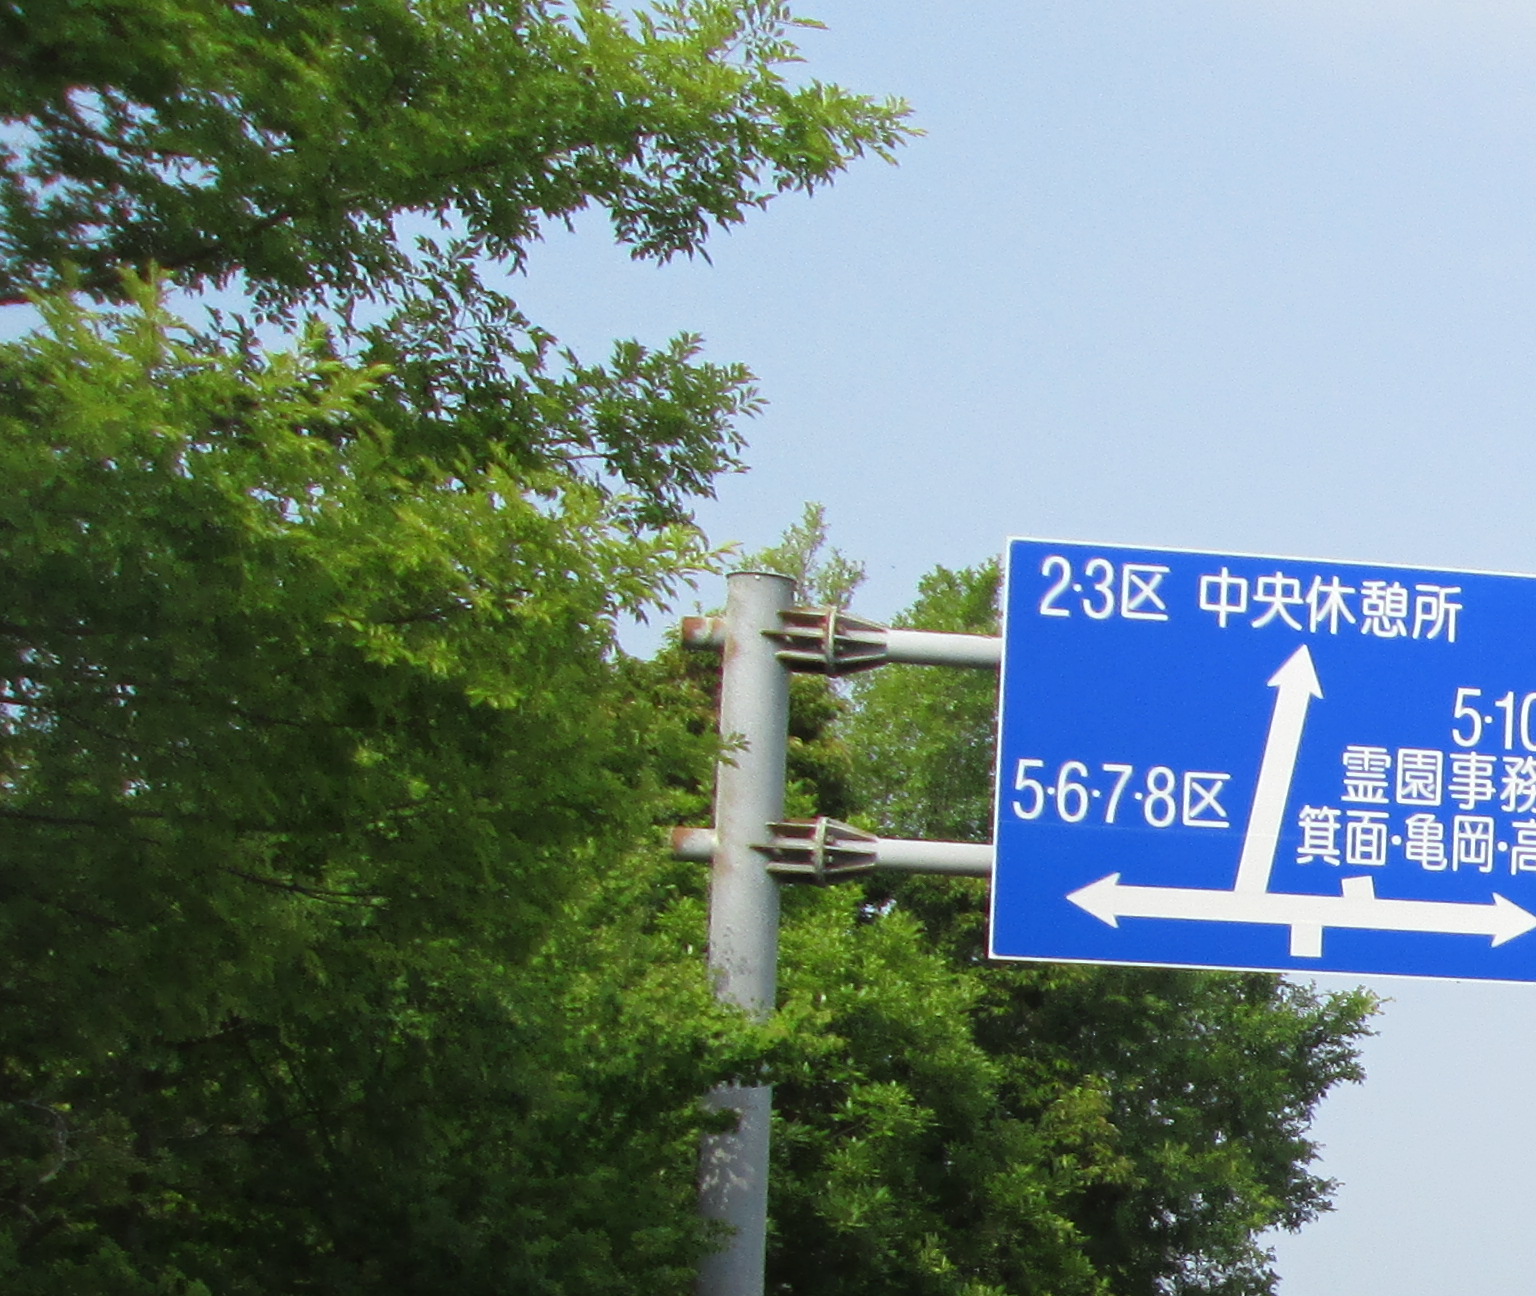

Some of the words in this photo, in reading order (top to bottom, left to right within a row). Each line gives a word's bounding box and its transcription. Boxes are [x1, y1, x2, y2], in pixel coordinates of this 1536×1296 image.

[1200, 567, 1462, 643] 中央休憩所
